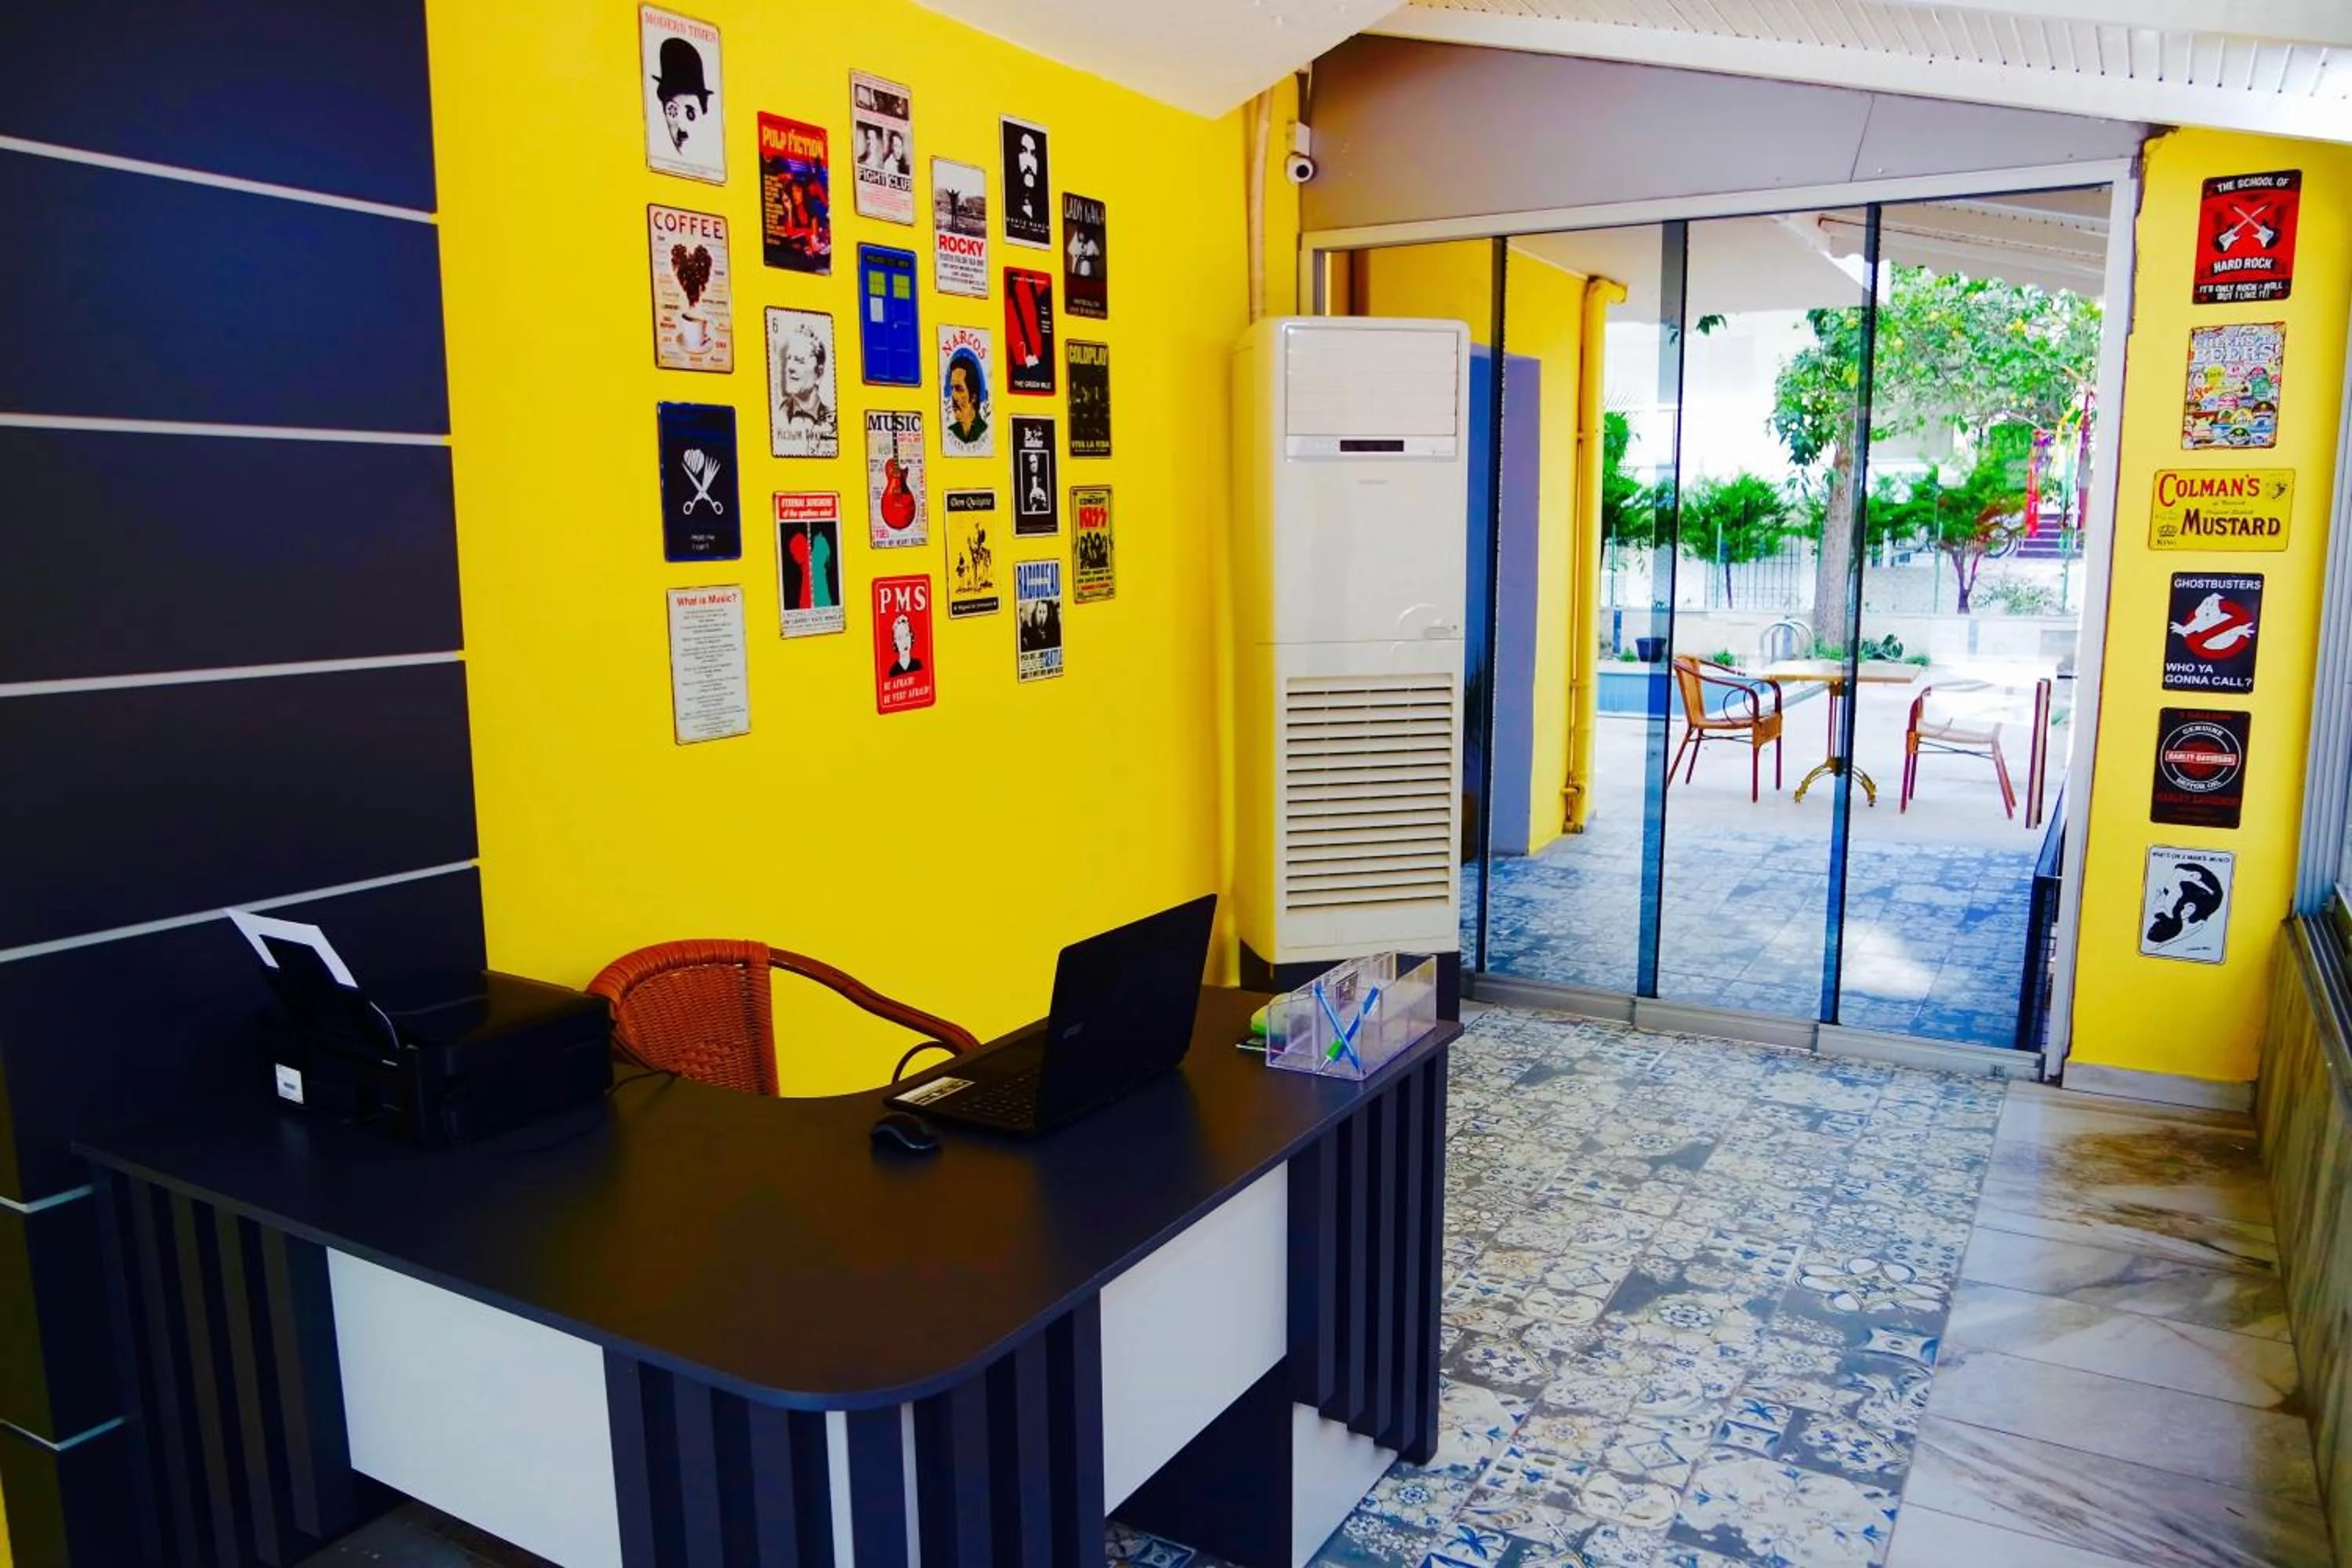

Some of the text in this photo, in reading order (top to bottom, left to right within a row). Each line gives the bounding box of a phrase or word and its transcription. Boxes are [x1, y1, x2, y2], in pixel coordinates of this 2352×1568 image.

[645, 13, 717, 42] MODERN TIMES
[763, 126, 824, 158] PULP FICTION
[858, 168, 912, 191] FIGHT CLUB
[2216, 177, 2289, 193] THE SCHOOL OF
[1065, 196, 1083, 222] LADY
[654, 212, 723, 239] COFFEE
[939, 234, 984, 257] ROCKY
[2214, 257, 2273, 273] HARD ROCK
[2236, 283, 2258, 292] ROCK
[2263, 281, 2283, 290] ROLL
[942, 330, 986, 359] NARCOS
[1069, 345, 1107, 365] COLDPLAY
[867, 415, 921, 431] MUSIC
[2159, 474, 2260, 507] COLMAN'S
[1079, 507, 1107, 528] KISS
[2180, 508, 2281, 535] MUSTARD
[2174, 579, 2261, 590] GHOSTBUSTERS
[677, 596, 696, 606] What
[708, 593, 737, 603] Music?
[880, 586, 926, 613] PMS
[2165, 663, 2214, 673] WHO YA
[2165, 674, 2209, 684] GONNA
[2182, 725, 2224, 736] GENUINE
